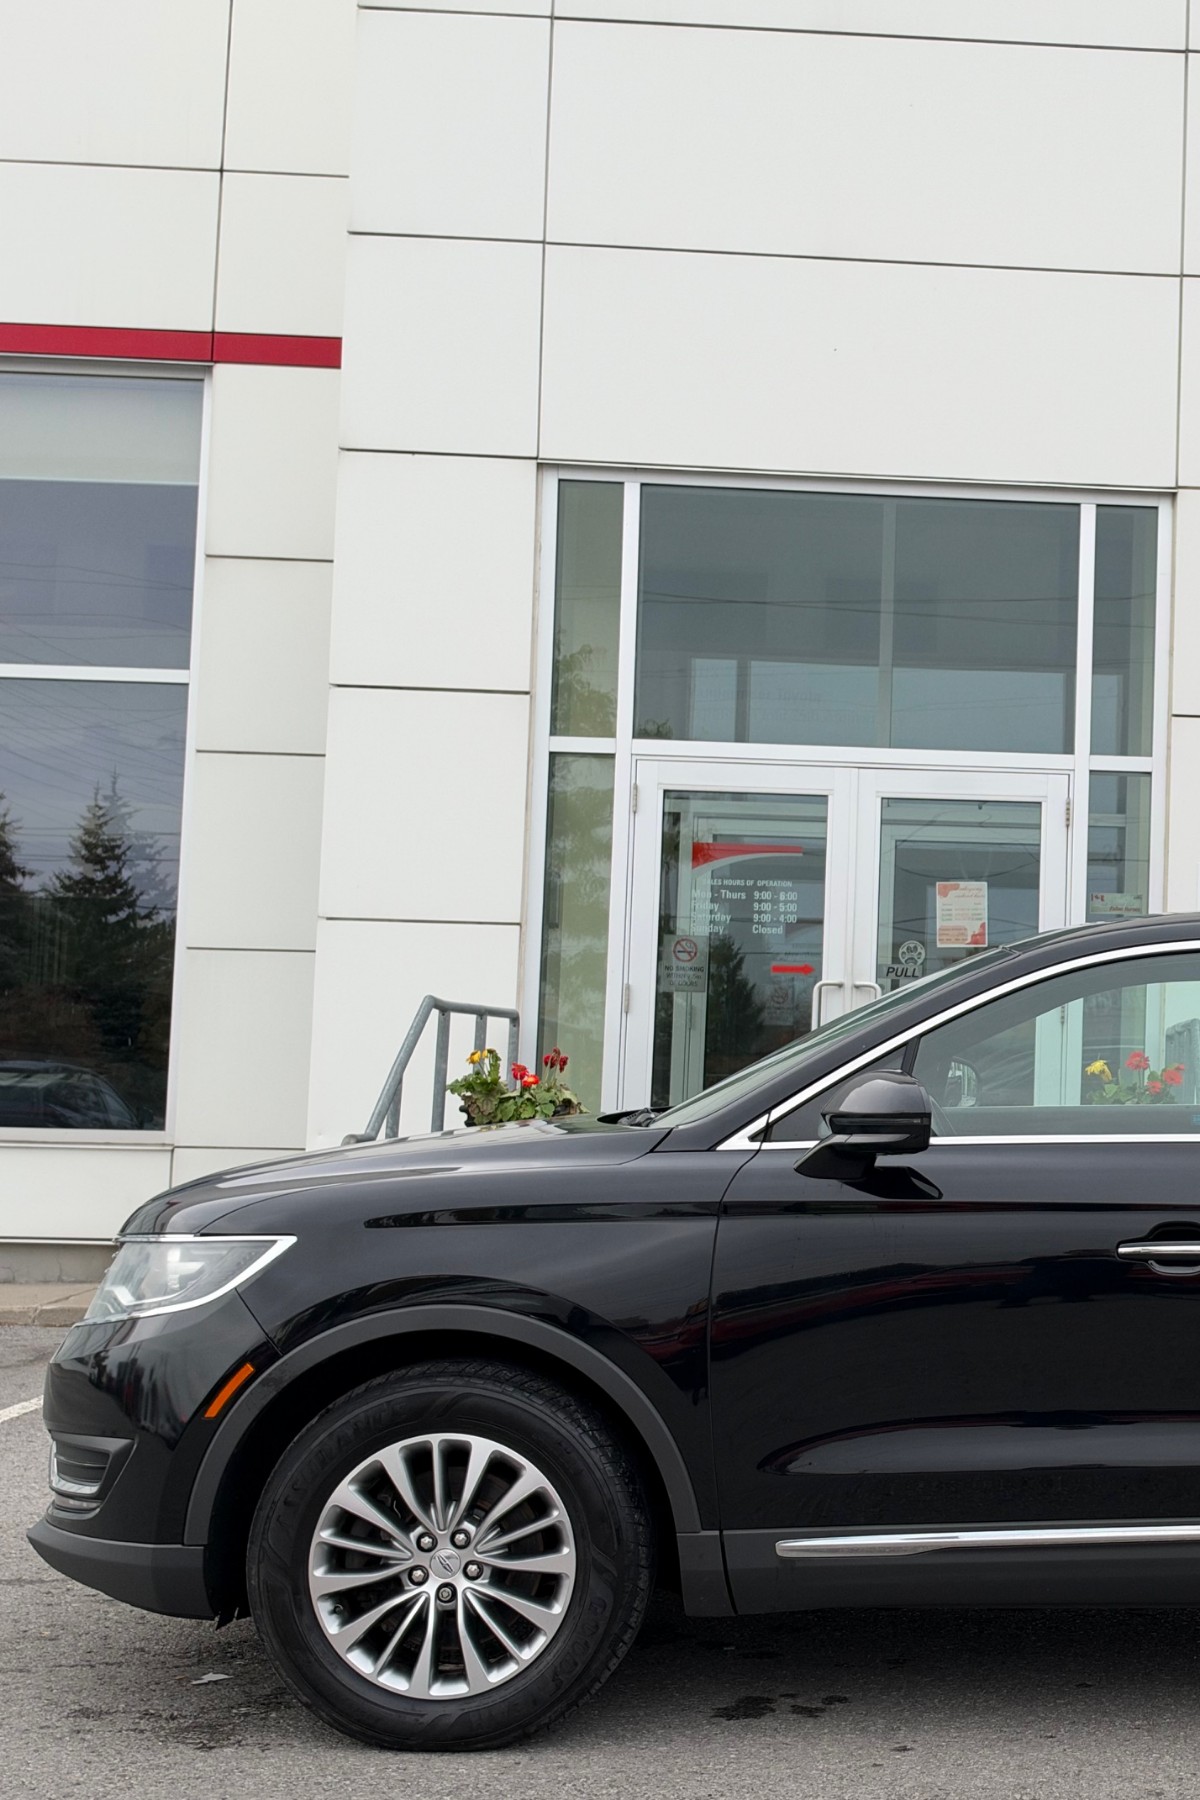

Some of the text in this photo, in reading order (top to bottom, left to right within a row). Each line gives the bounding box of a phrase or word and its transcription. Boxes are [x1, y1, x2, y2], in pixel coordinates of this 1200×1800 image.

[723, 879, 745, 887] HOURS
[746, 879, 754, 887] OF
[756, 880, 793, 888] OPERATION
[720, 889, 747, 900] Thurs
[753, 890, 772, 901] 9:00
[779, 891, 798, 902] 6:00
[691, 900, 720, 912] Friday
[753, 902, 772, 912] 9:00
[779, 902, 798, 913] 5:00
[690, 912, 731, 924] Saturday
[752, 913, 772, 923] 9:00
[779, 914, 798, 924] 4:00
[690, 923, 784, 936] Sunday Closed
[675, 965, 704, 973] SMOKING
[886, 966, 919, 978] PULL
